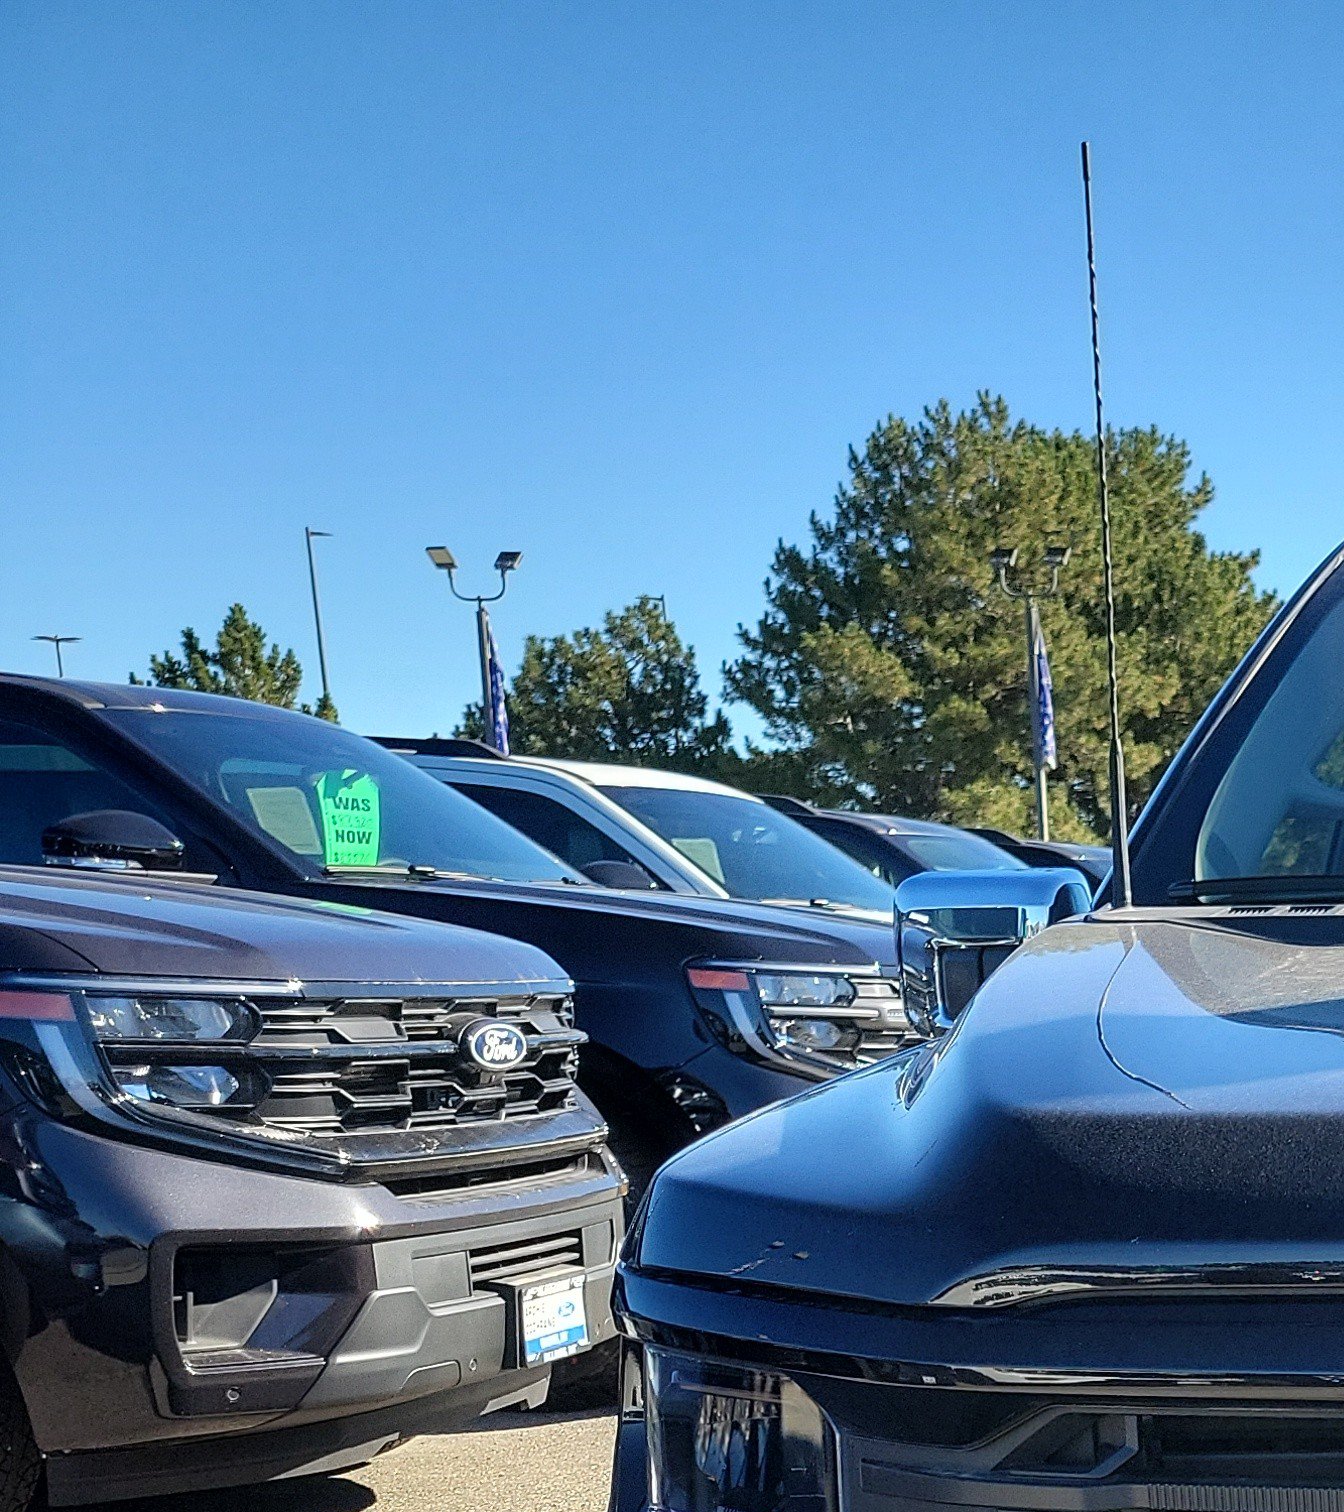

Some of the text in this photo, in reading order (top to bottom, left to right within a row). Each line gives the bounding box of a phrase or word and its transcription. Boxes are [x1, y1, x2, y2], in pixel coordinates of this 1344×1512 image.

[332, 796, 371, 812] WAS
[335, 829, 373, 845] NOW
[482, 1029, 518, 1061] Ford
